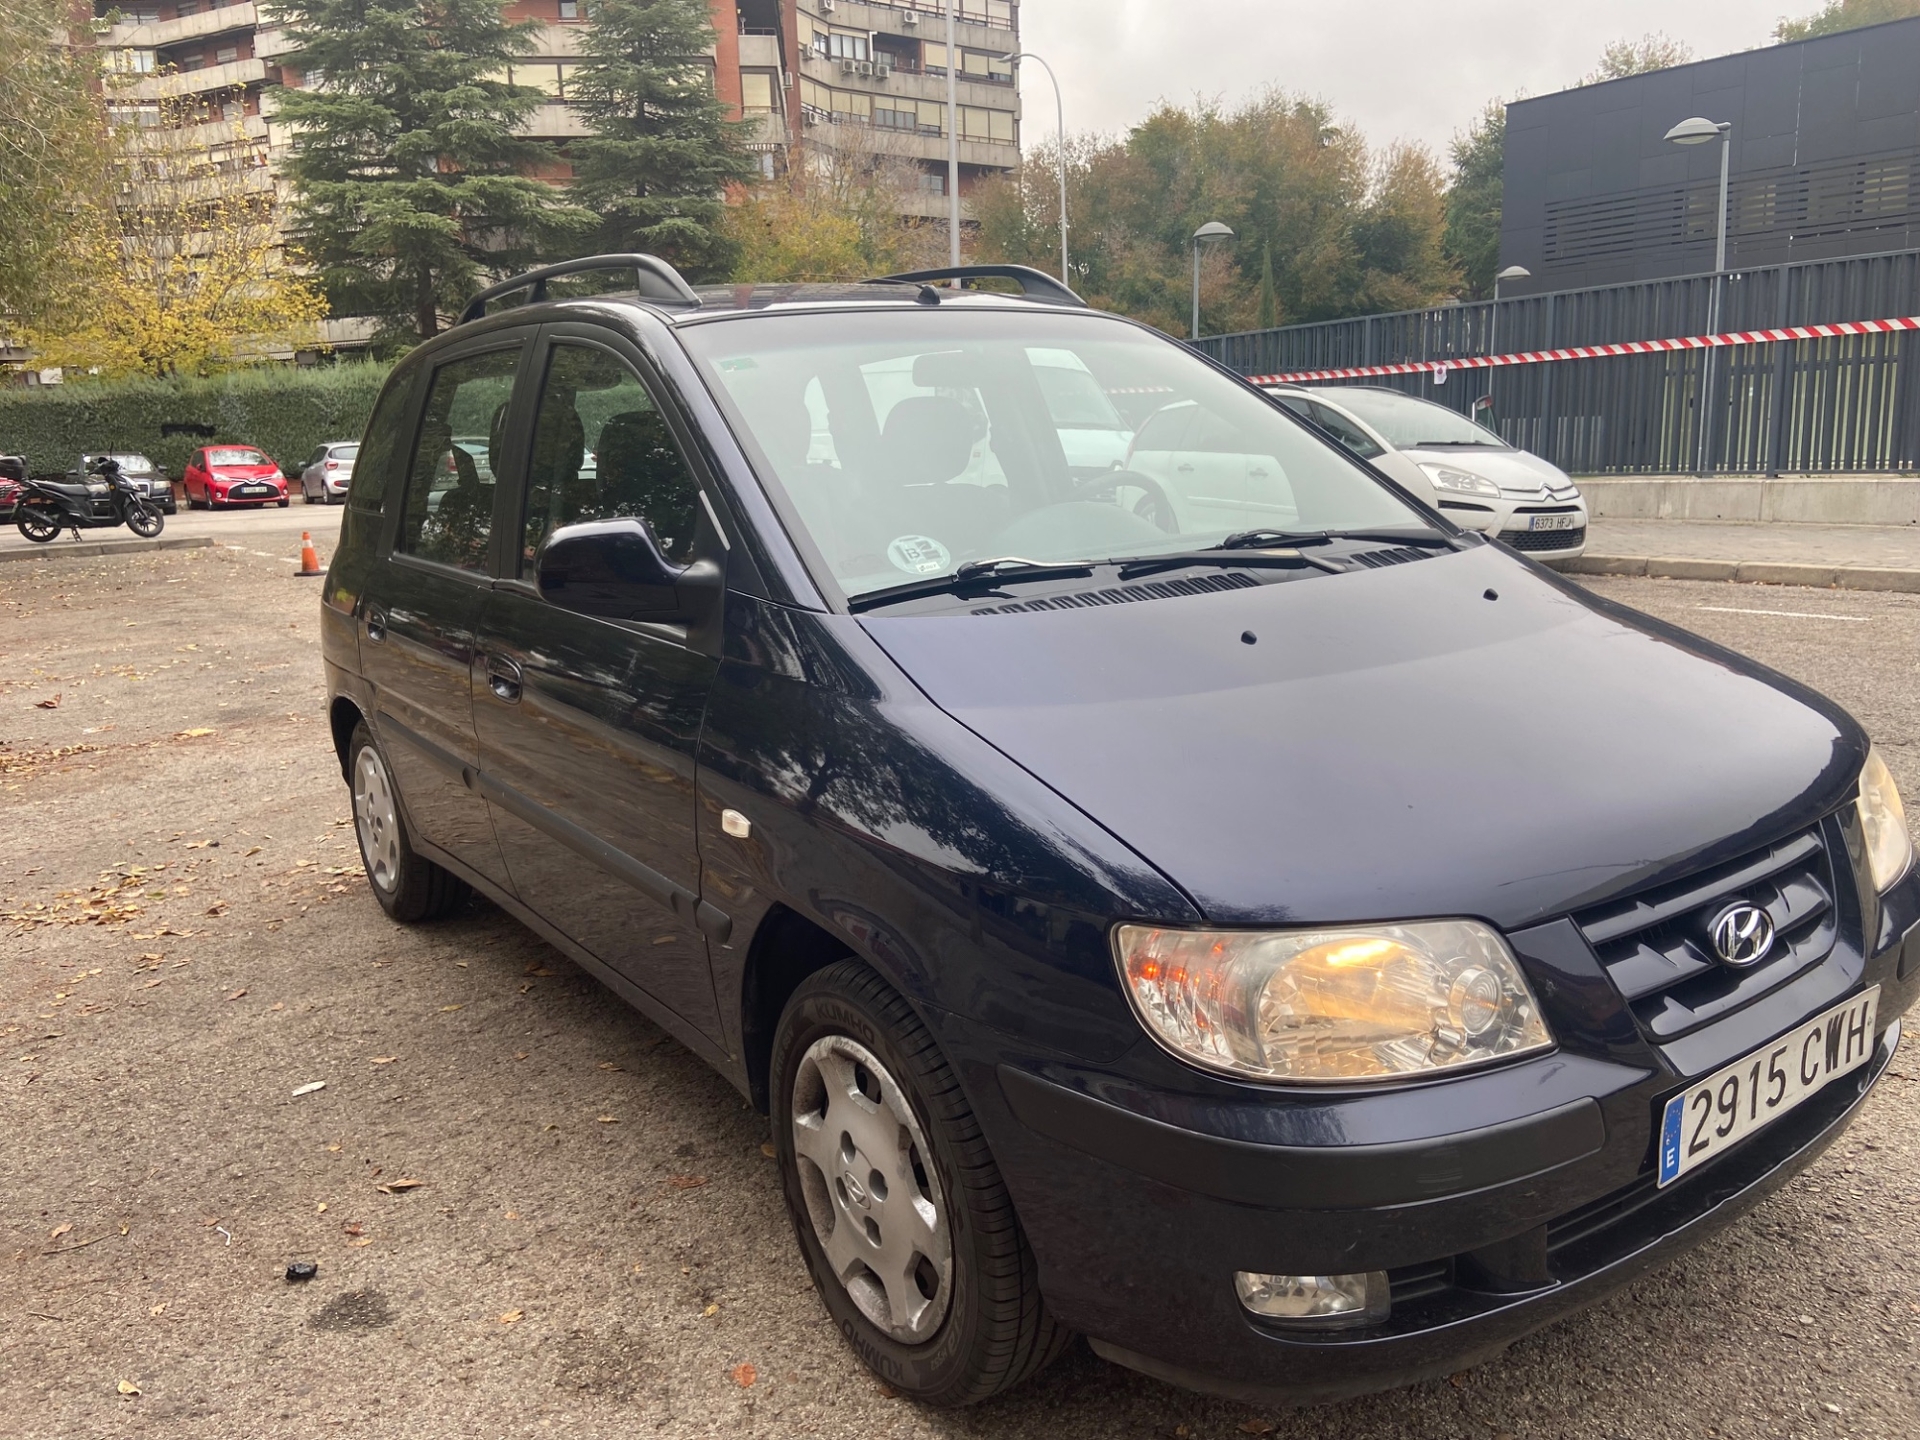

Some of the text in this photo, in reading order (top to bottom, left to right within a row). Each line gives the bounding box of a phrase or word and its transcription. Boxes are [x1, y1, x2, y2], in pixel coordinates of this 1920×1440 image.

[1535, 517, 1553, 529] 6373
[815, 1003, 875, 1045] KUMHO
[1688, 1000, 1869, 1158] 2915 CWH
[1666, 1147, 1675, 1168] E
[842, 1318, 904, 1380] KUMHO
